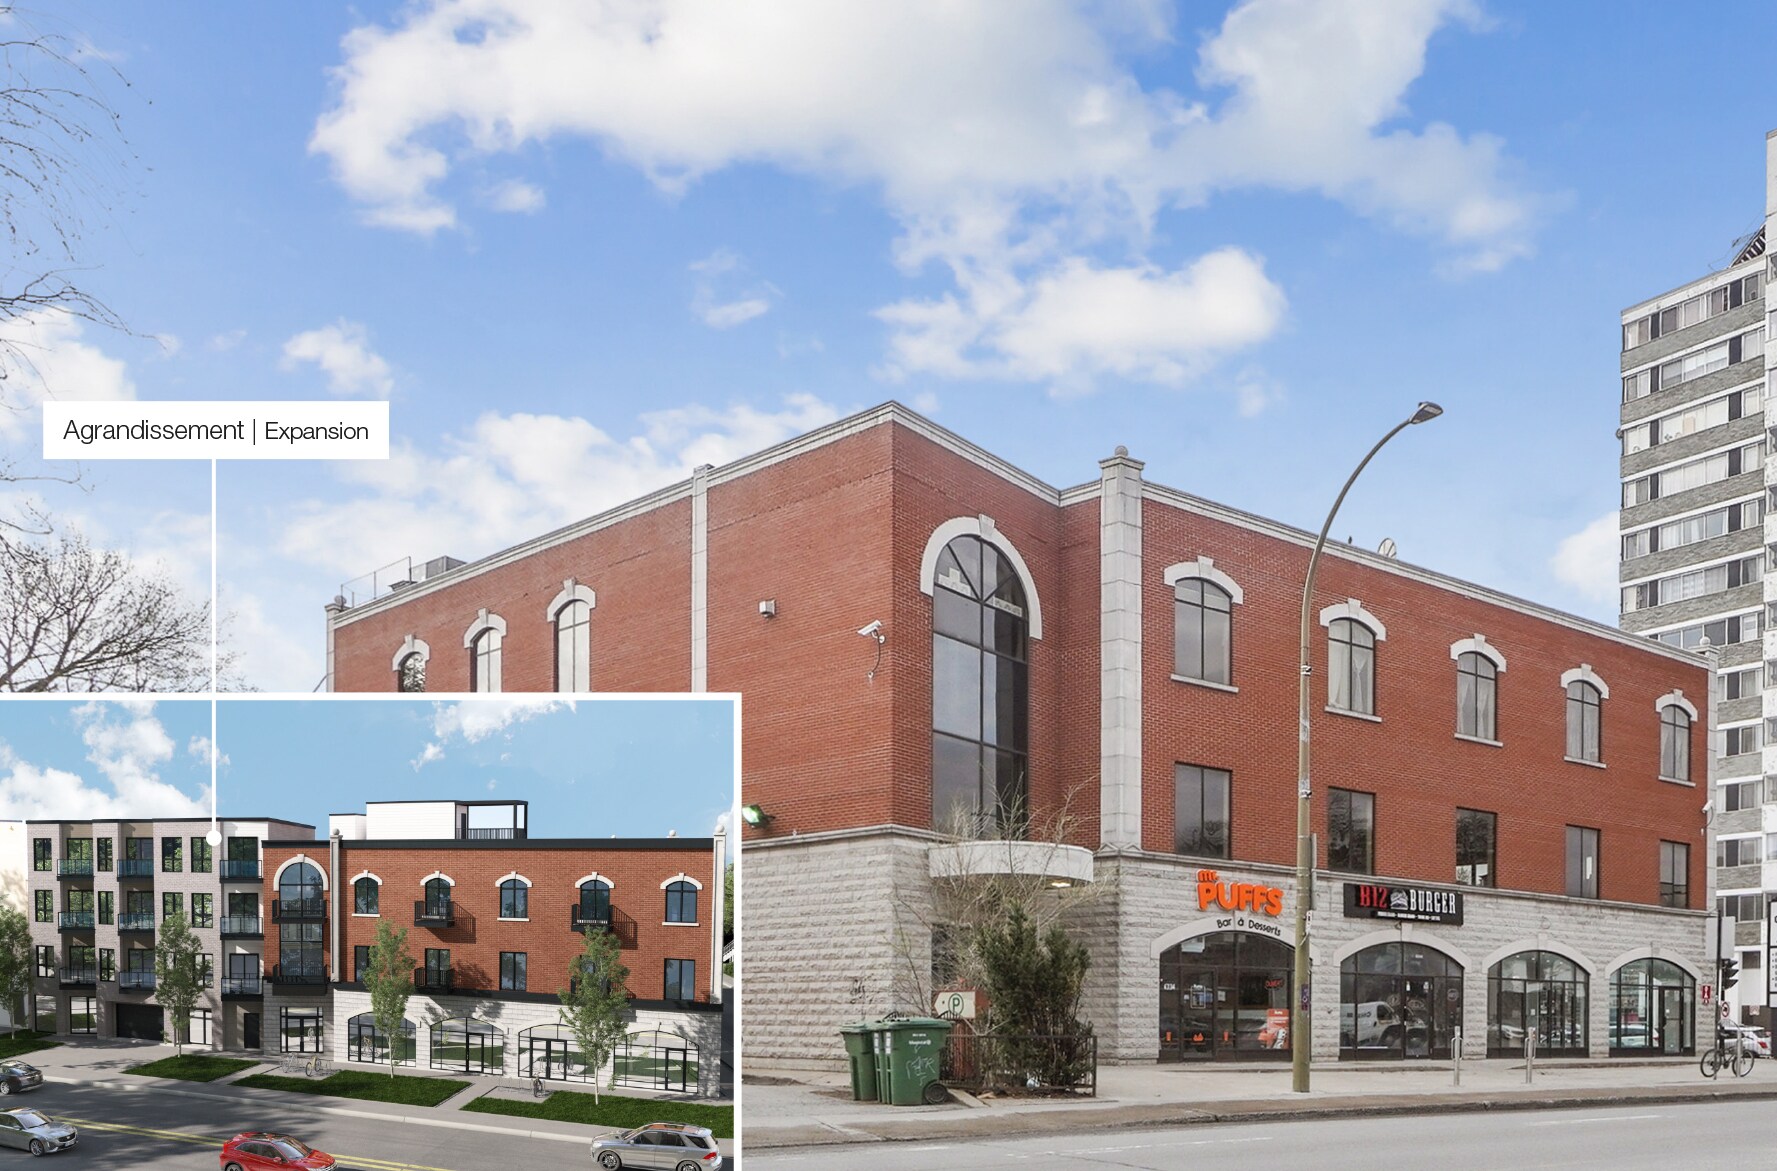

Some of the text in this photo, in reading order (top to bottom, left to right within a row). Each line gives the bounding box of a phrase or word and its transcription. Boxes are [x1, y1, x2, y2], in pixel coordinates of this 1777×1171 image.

[1197, 881, 1284, 917] PUFFS
[1410, 889, 1456, 914] BURGER
[1217, 918, 1232, 928] Bar
[1248, 919, 1281, 936] Desserts
